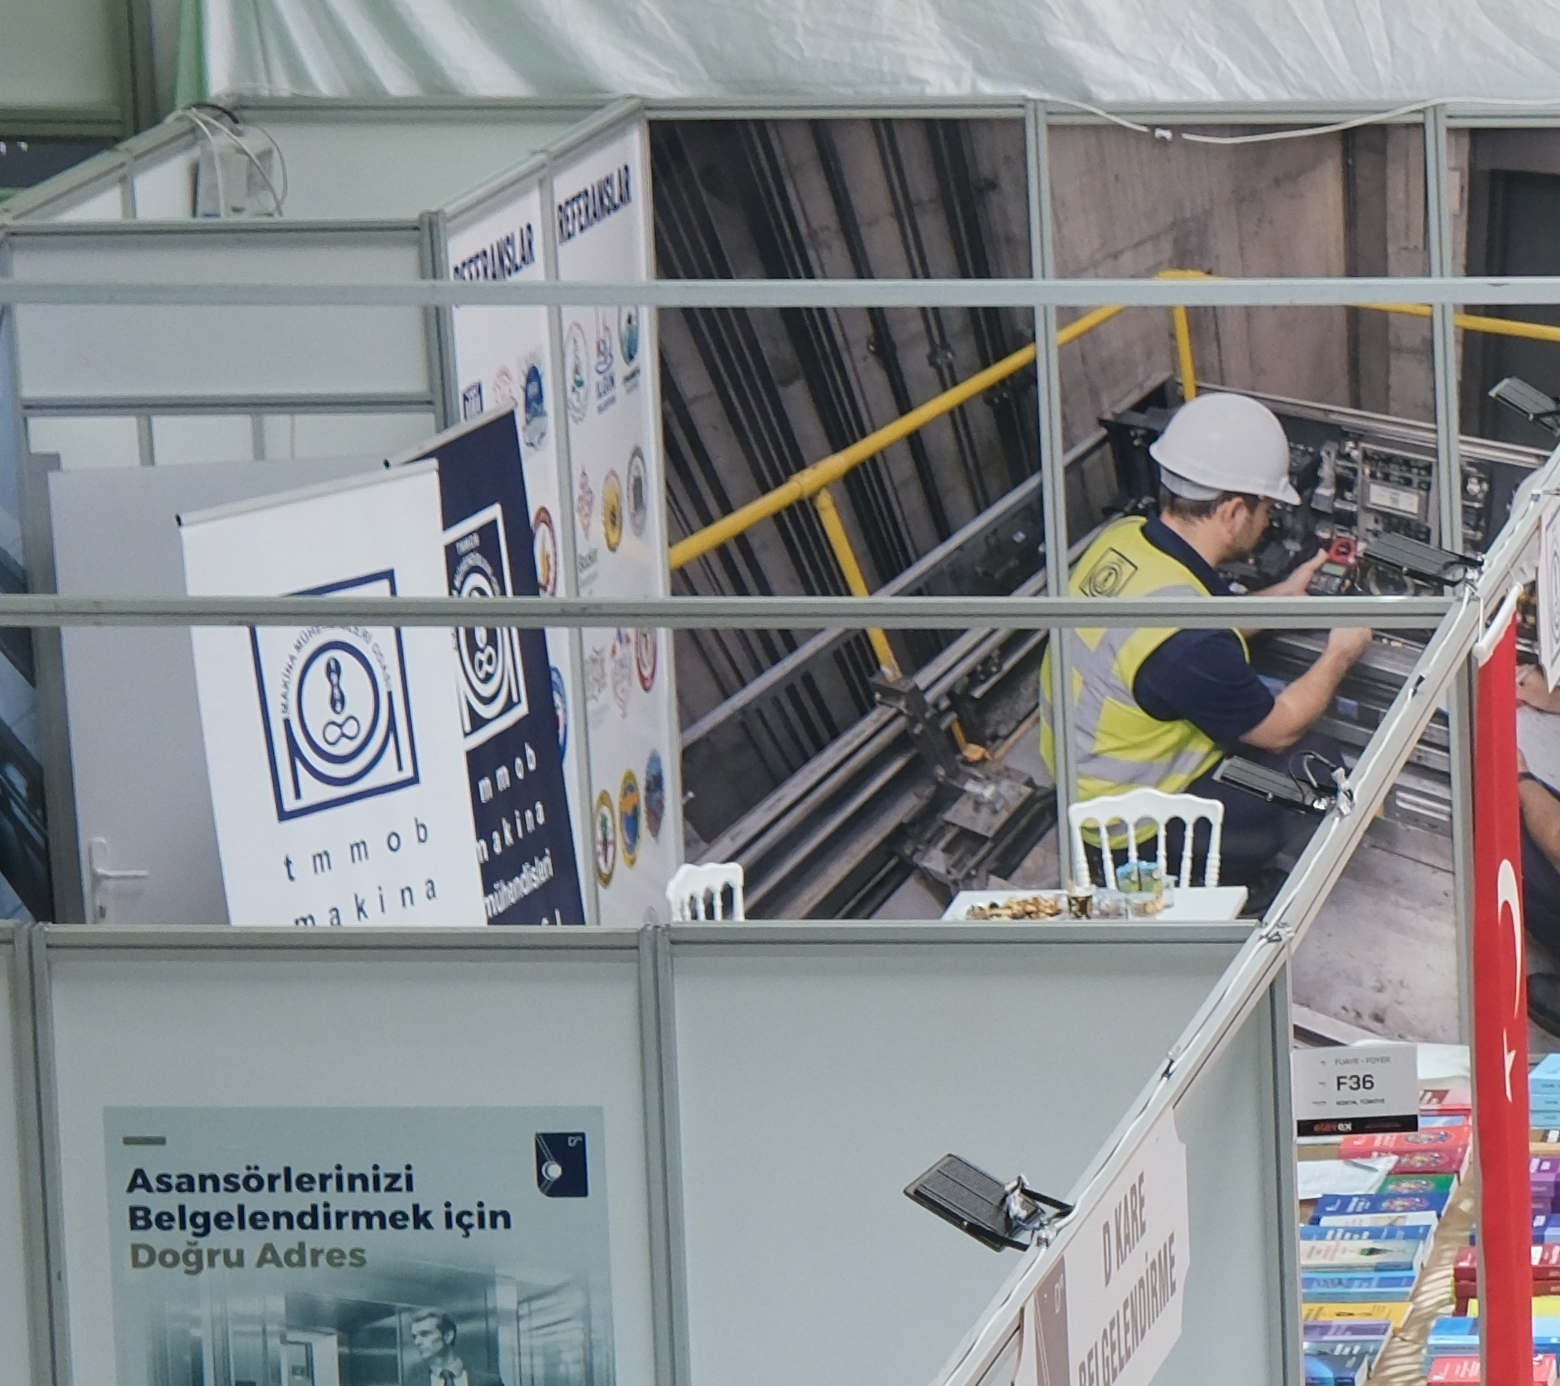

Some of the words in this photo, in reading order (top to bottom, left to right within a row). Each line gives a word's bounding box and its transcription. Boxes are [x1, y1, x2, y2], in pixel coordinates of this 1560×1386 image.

[557, 164, 633, 246] REFERANSLAR
[477, 741, 538, 804] mmob
[283, 816, 430, 882] tmmob
[1336, 1074, 1375, 1092] F36
[126, 1166, 416, 1196] Asansörlerinizi
[128, 1204, 434, 1238] Belgelendirmek
[444, 1203, 512, 1239] için
[1102, 1219, 1113, 1289] D
[1114, 1170, 1147, 1272] KARE
[130, 1239, 246, 1277] Doğru
[256, 1242, 368, 1270] Adres
